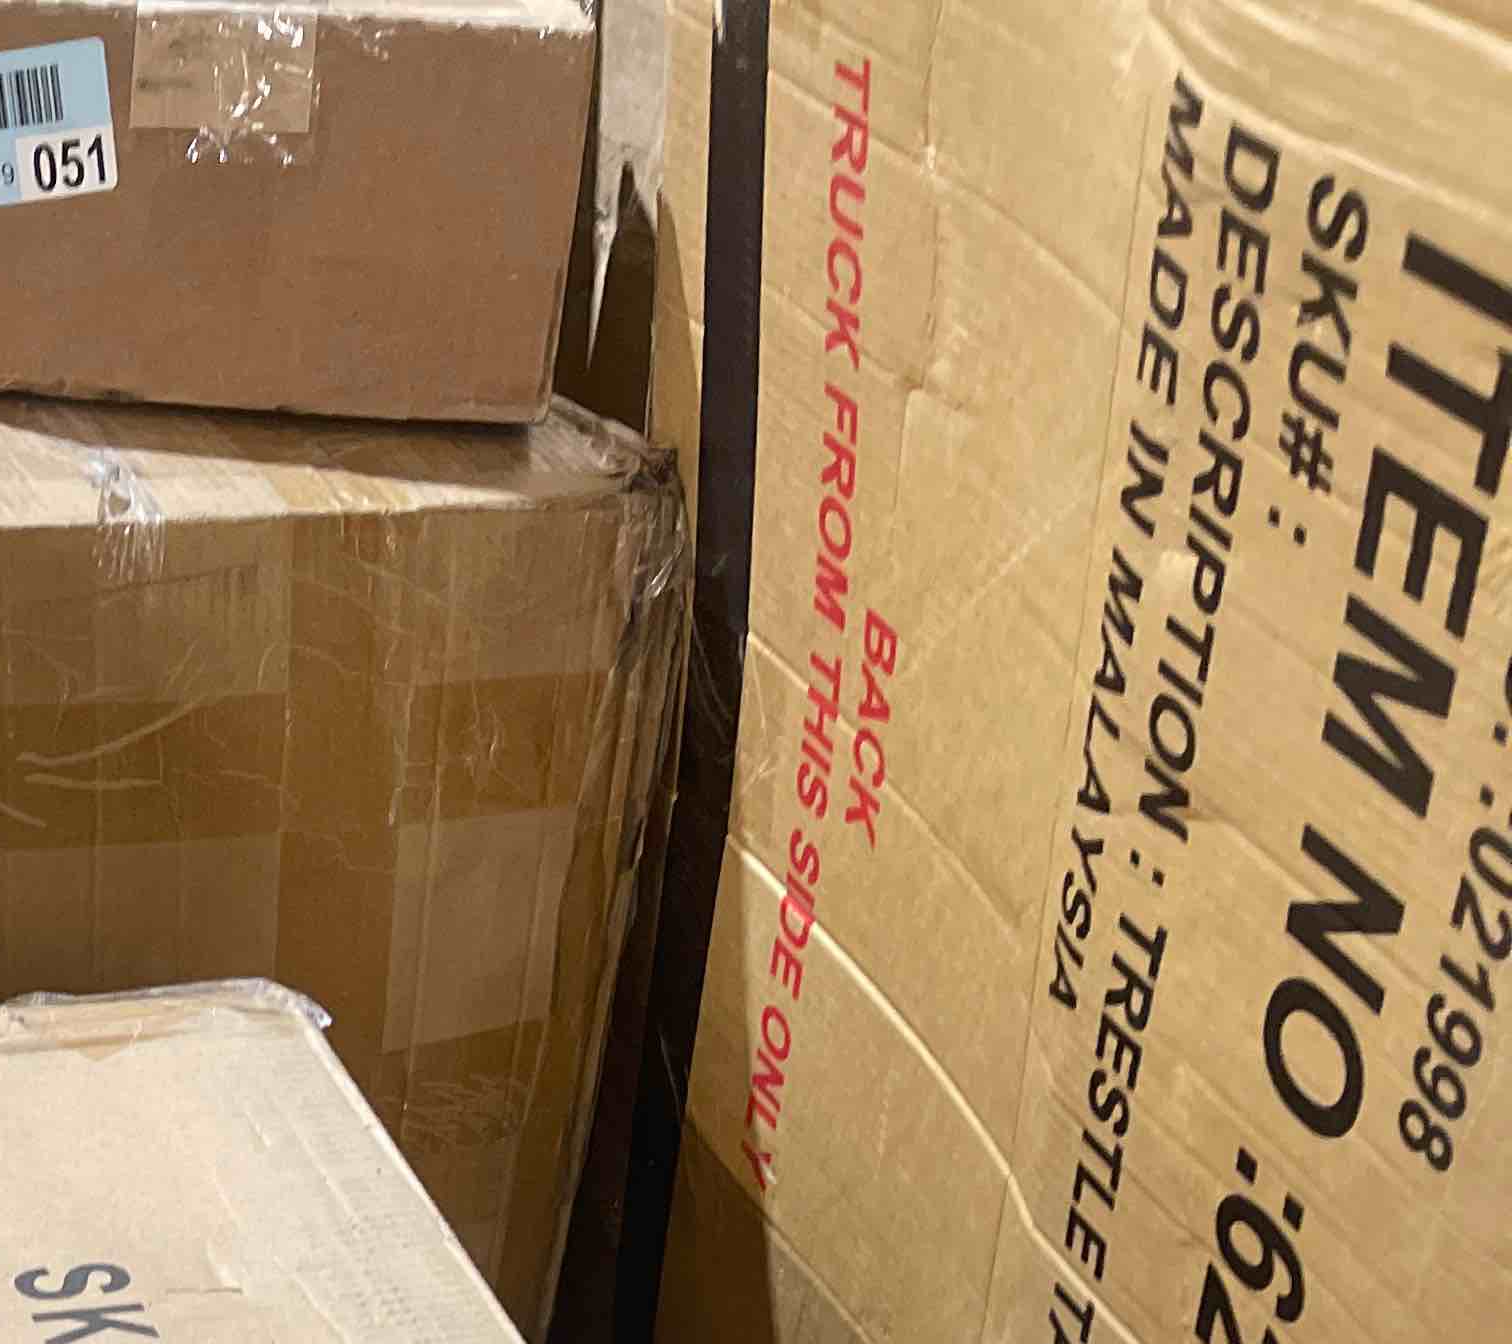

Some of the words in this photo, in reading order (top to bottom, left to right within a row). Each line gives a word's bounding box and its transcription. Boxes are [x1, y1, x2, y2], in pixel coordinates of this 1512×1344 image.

[32, 133, 109, 193] 051
[823, 58, 872, 374] TRUCK
[1138, 72, 1204, 406] MADE
[811, 386, 859, 633] FROM
[1120, 426, 1170, 538] IN
[1138, 119, 1282, 842] DESCRIPTION
[1322, 230, 1512, 821] ITEM
[794, 663, 843, 812] THIS
[844, 616, 899, 849] BACK
[1048, 553, 1144, 1011] MALAYSIA
[772, 830, 821, 1002] SIDE
[742, 1006, 792, 1196] ONLY
[1065, 911, 1168, 1281] TRESTLE
